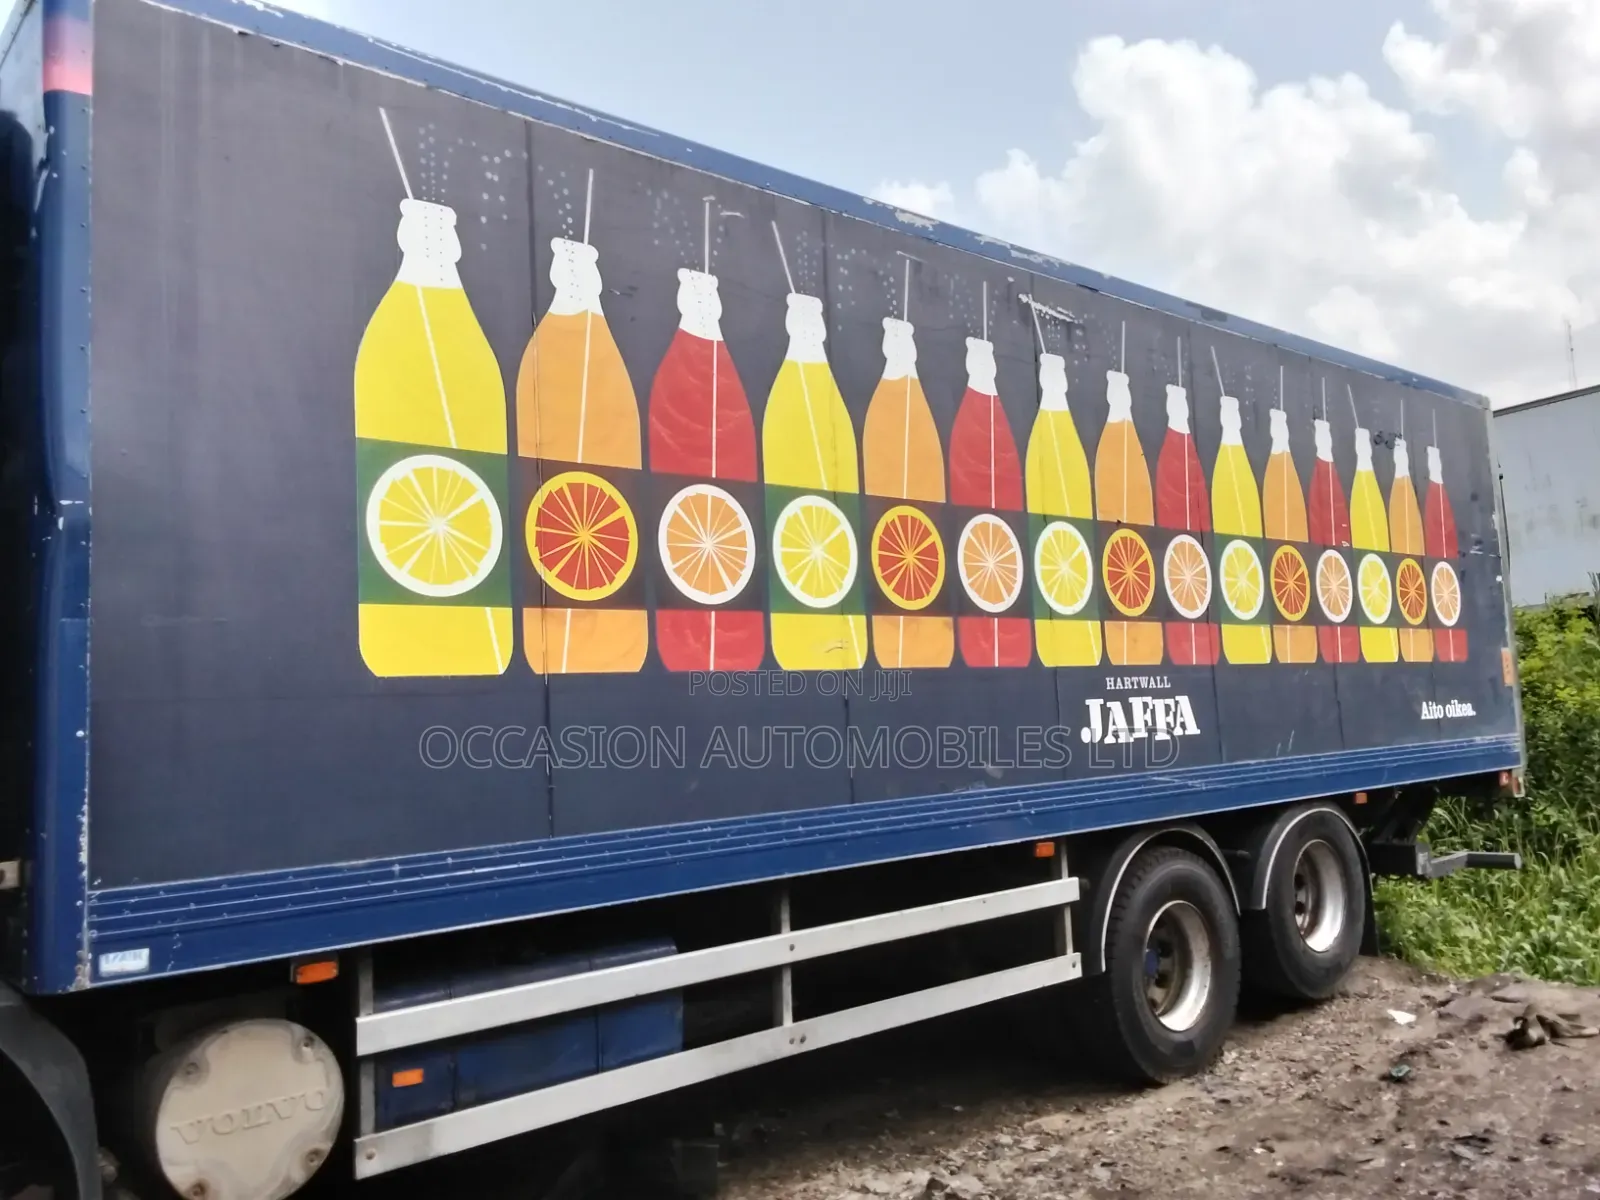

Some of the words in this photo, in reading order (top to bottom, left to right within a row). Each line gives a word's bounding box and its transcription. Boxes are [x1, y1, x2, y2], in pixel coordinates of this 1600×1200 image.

[1106, 676, 1171, 690] HARTWALL
[1080, 695, 1201, 744] JAFFA
[1421, 701, 1444, 719] Aito
[1445, 699, 1476, 718] oikea.
[170, 1089, 325, 1145] VOLVO
